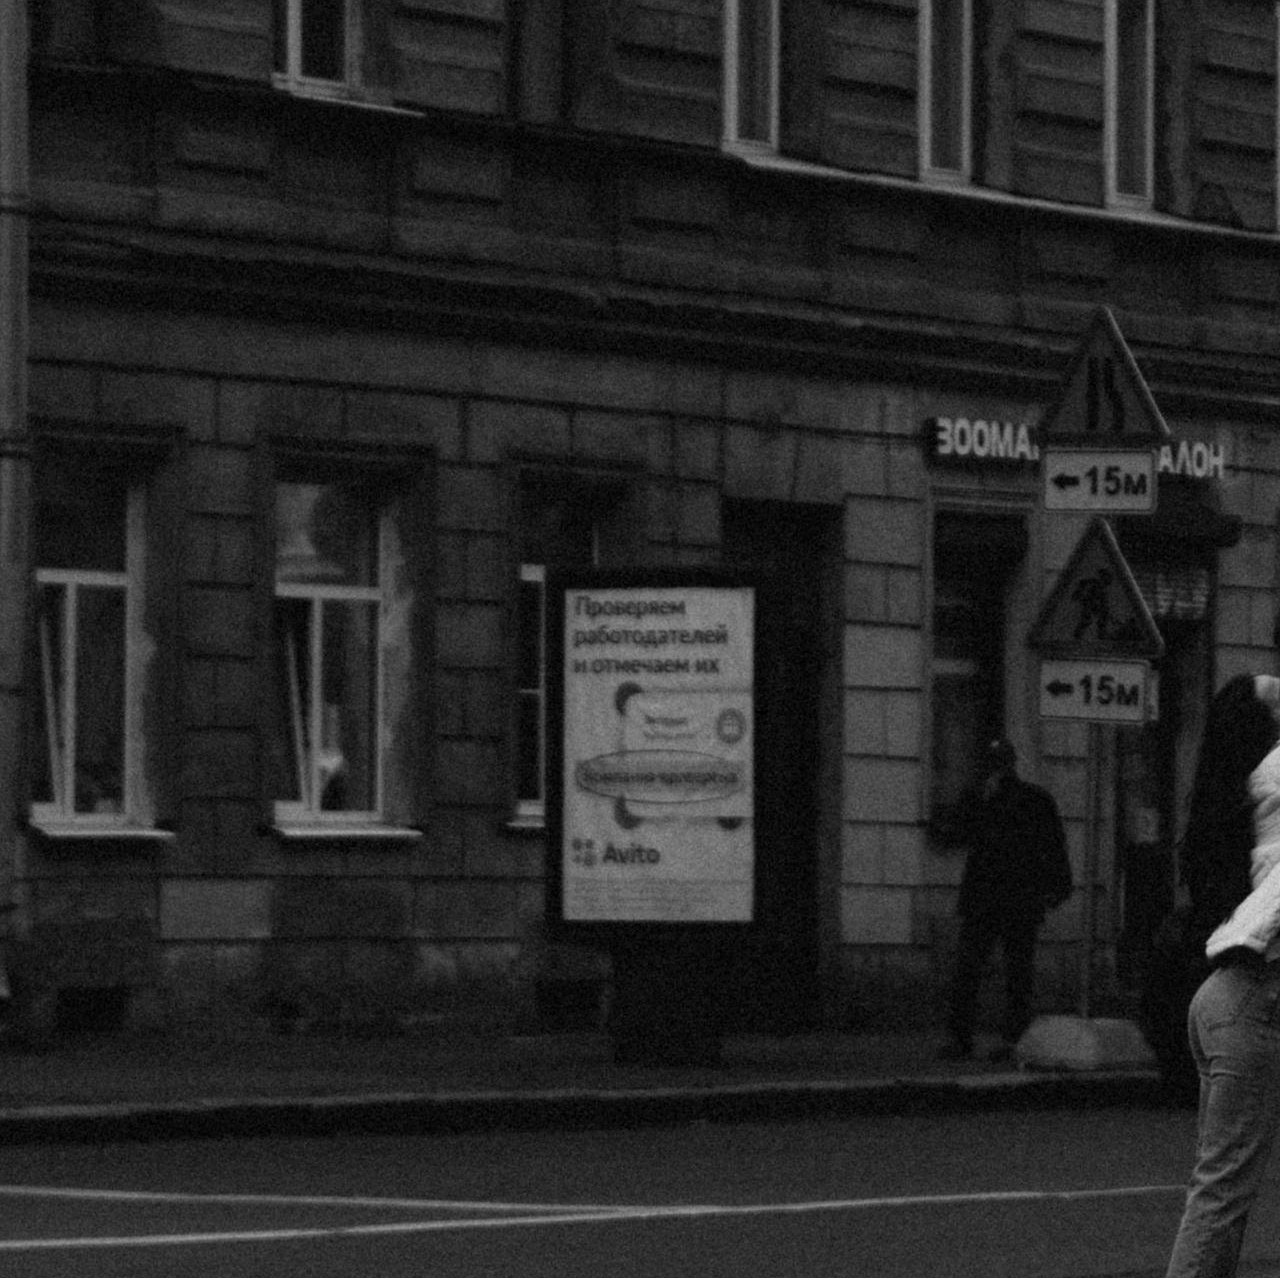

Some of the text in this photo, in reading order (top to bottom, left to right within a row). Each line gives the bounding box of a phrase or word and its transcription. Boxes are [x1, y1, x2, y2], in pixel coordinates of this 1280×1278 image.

[937, 417, 1225, 479] ЗООМА АЛОН
[575, 595, 687, 619] Проверяем
[574, 624, 729, 648] работодателей
[574, 659, 720, 674] и отмечаем их
[602, 841, 661, 865] Avito
